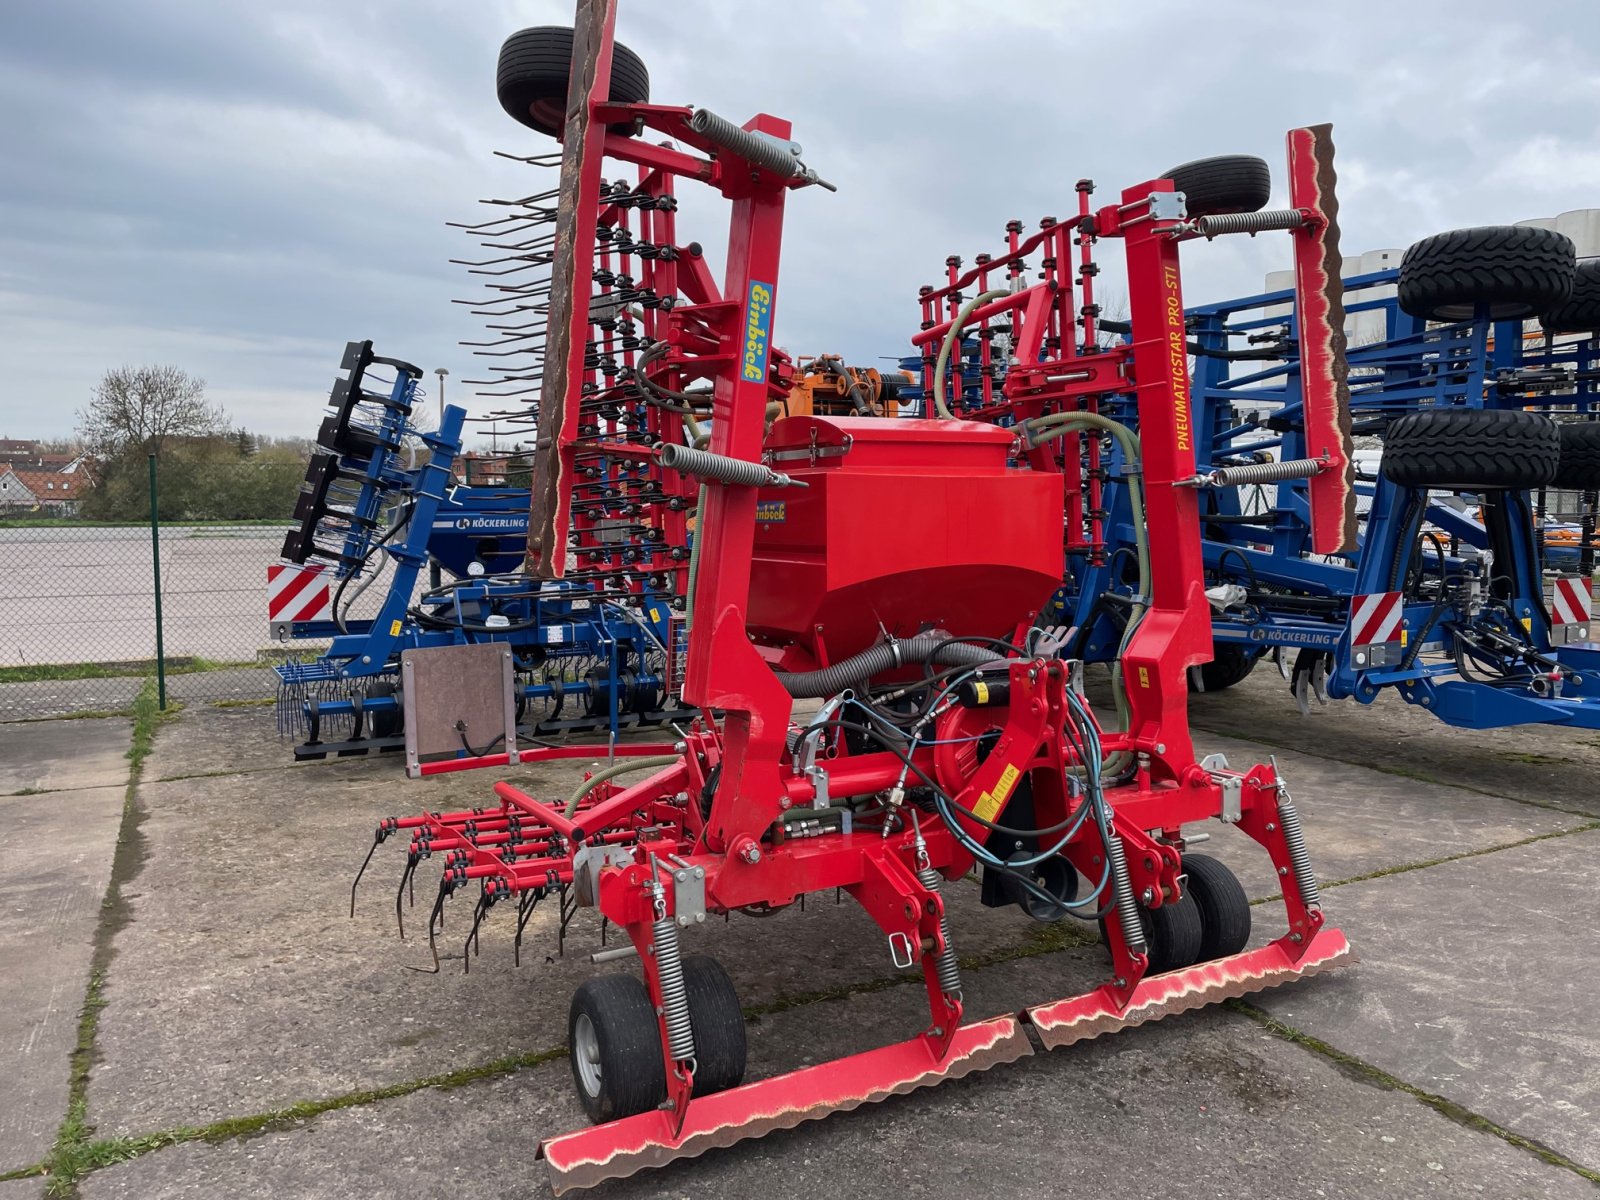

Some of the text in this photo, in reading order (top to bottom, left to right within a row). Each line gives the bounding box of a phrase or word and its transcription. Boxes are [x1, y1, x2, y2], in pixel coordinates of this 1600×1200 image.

[744, 284, 770, 380] Einböck
[1164, 266, 1189, 451] PNEUMATICSTAR PRO-STI
[756, 503, 785, 520] inböck
[472, 517, 525, 528] KÖCKERLING
[1267, 629, 1331, 645] KÖCKERLING
